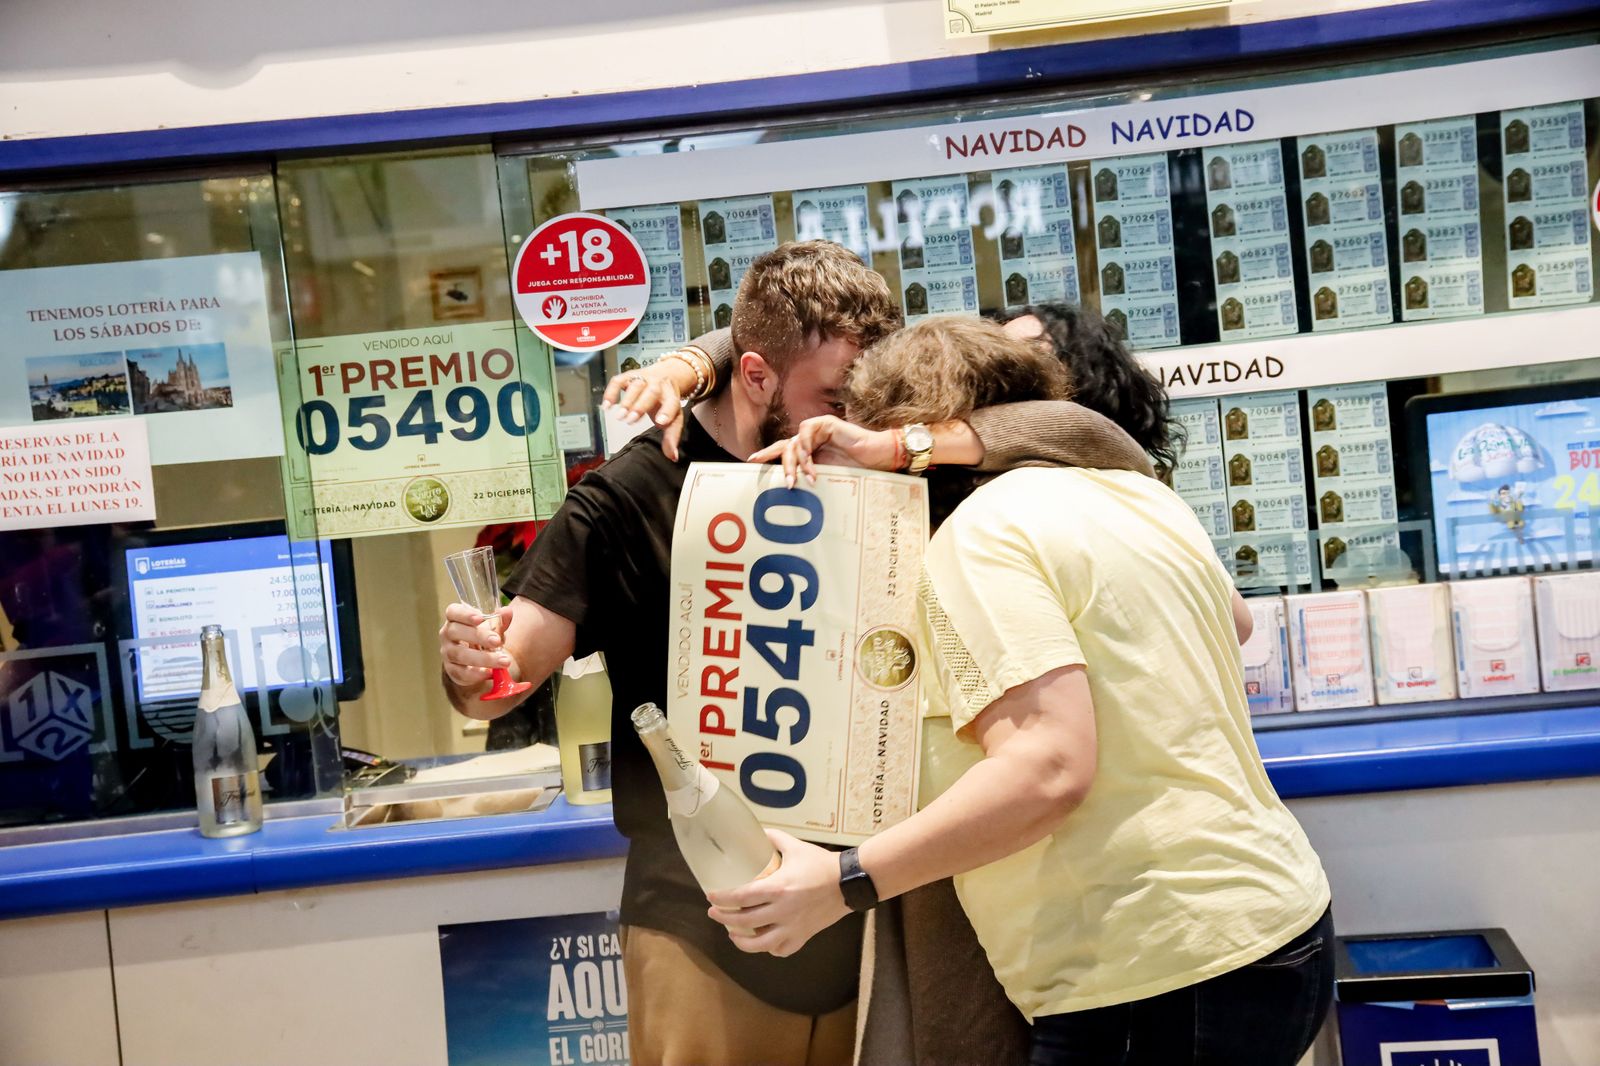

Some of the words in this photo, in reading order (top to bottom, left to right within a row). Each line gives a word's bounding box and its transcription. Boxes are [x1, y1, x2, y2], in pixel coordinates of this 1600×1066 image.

[946, 124, 1087, 160] NAVIDAD
[1111, 108, 1255, 145] NAVIDAD
[1118, 166, 1152, 177] 97024
[725, 209, 759, 219] 70048
[1121, 214, 1155, 225] 97024
[924, 233, 957, 245] 30206
[540, 228, 614, 272] +18
[1124, 260, 1159, 272] 97024
[528, 280, 551, 288] JUEGA
[553, 278, 568, 286] CON
[570, 274, 634, 284] RESPONSABILIDAD
[570, 294, 604, 302] PROHIBIDA
[27, 304, 104, 322] TENEMOS
[108, 297, 176, 316] LOTERÍA
[180, 296, 221, 312] PARA
[572, 307, 628, 317] AUTOPROHIBIDOS
[642, 311, 671, 322] 5889
[1128, 306, 1162, 318] 97024
[53, 326, 86, 342] LOS
[90, 320, 172, 339] SÁBADOS
[176, 318, 202, 333] DE:
[363, 336, 420, 352] VENDIDO
[423, 331, 454, 347] AQUÍ
[307, 363, 336, 396] 1er
[340, 348, 515, 394] PREMIO
[296, 381, 541, 455] 05490
[1169, 414, 1202, 424] 0047
[1249, 405, 1283, 417] 70048
[75, 433, 96, 446] DE
[100, 431, 120, 444] LA
[1, 451, 29, 468] RÍA
[33, 452, 52, 465] DE
[57, 447, 125, 464] NAVIDAD
[1174, 460, 1207, 470] 0047
[3, 470, 26, 484] NO
[30, 466, 81, 482] HAYAN
[85, 464, 122, 479] SIDO
[45, 485, 66, 498] SE
[68, 479, 143, 497] PONDRÁN
[473, 491, 485, 500] 22
[1553, 472, 1600, 509] 24
[48, 501, 68, 515] EL
[71, 498, 121, 514] LUNES
[124, 496, 143, 510] 19.
[353, 500, 397, 511] NAVIDAD
[887, 512, 900, 582] DICIEMBRE
[1259, 544, 1290, 554] 7004
[887, 585, 896, 598] 22
[679, 581, 694, 622] AQUÍ
[700, 512, 747, 738] PREMIO
[739, 487, 824, 809] 05490
[676, 625, 694, 700] VENDIDO
[877, 699, 890, 757] NAVIDAD
[872, 772, 886, 824] LOTERÍA
[550, 936, 572, 961] ¿Y
[576, 935, 594, 959] SI
[598, 934, 622, 957] CA
[547, 959, 628, 1021] AQU
[549, 1036, 575, 1066] EL
